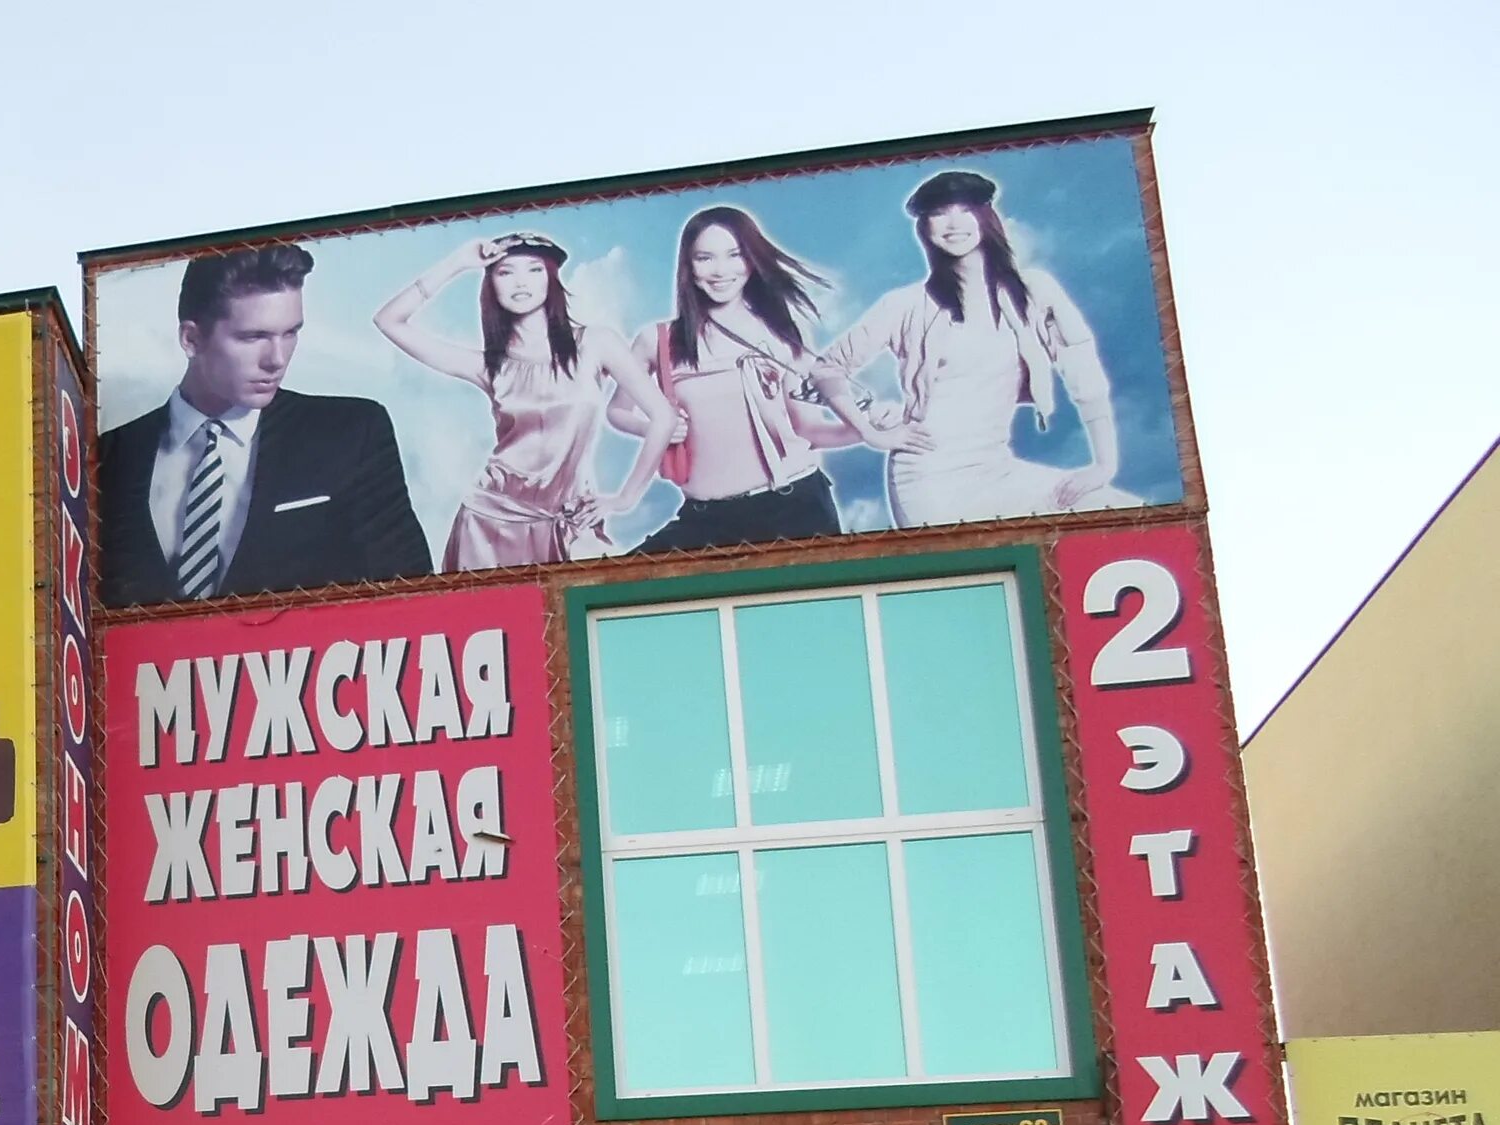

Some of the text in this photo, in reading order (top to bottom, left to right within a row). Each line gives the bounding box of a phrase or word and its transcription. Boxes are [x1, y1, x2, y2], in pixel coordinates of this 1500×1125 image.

[1083, 558, 1192, 688] 2
[134, 628, 513, 768] МУЖСКАЯ
[143, 765, 508, 903] ЖЕНСКАЯ
[124, 923, 545, 1115] ОДЕЖДА
[1355, 1089, 1467, 1107] магазин
